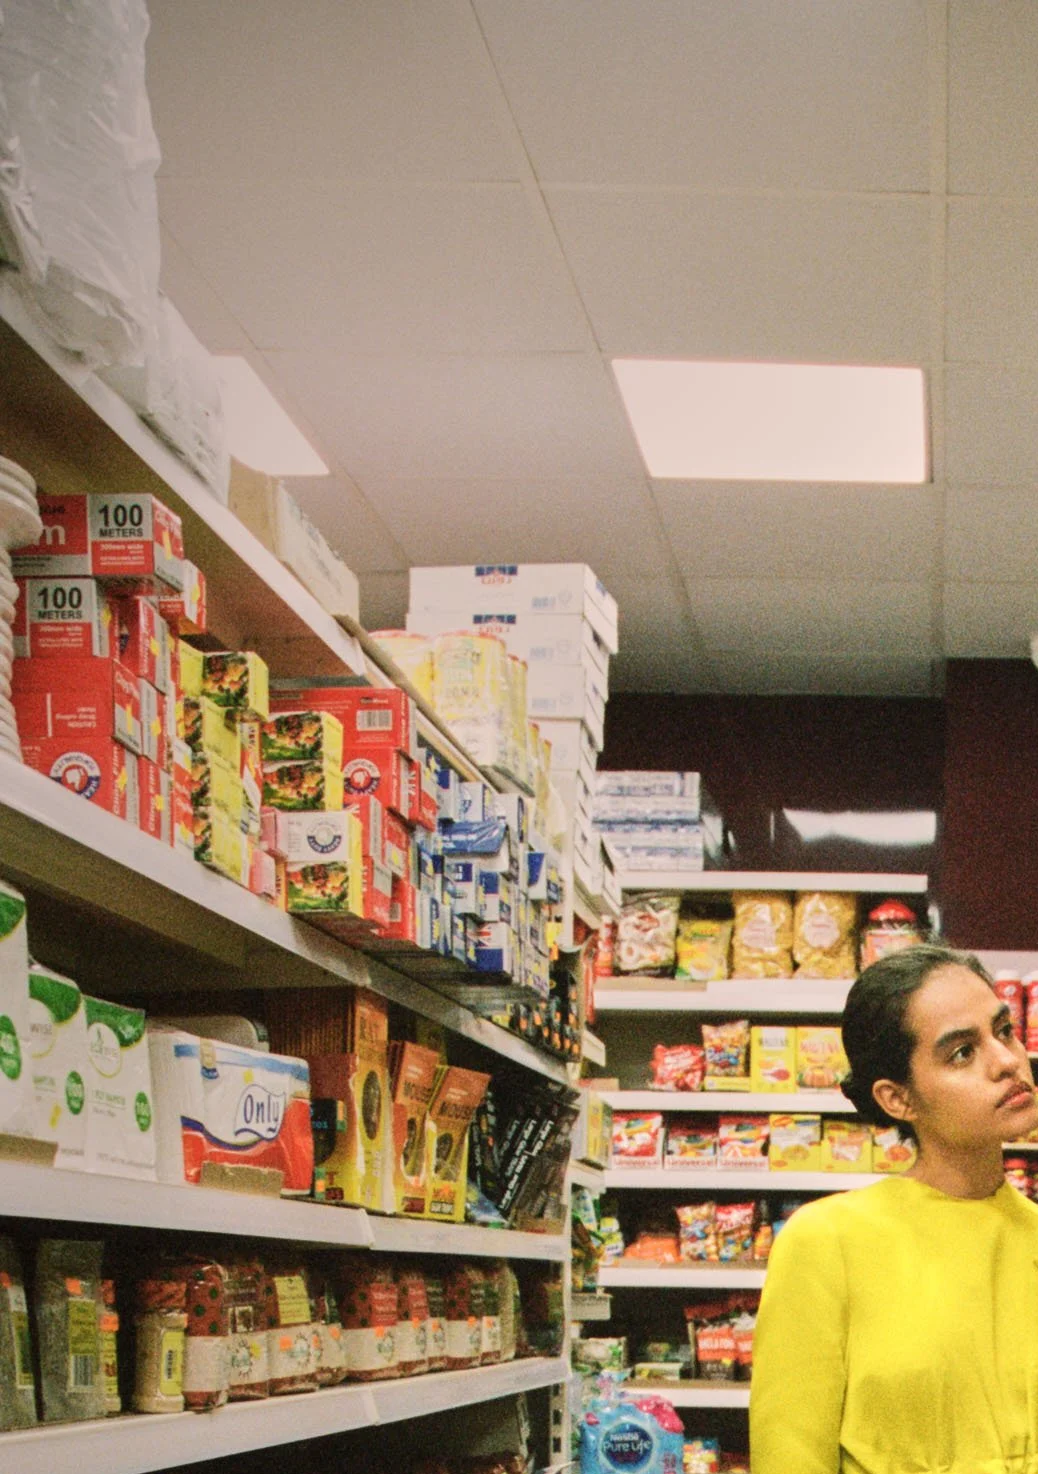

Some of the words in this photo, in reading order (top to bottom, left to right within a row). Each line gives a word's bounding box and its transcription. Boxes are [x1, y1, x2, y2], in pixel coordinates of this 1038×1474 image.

[98, 504, 143, 527] 100
[99, 528, 143, 538] METERS
[38, 587, 82, 609] 100
[38, 610, 82, 620] METERS
[243, 1094, 280, 1131] Only
[603, 1440, 631, 1453] Pure
[632, 1439, 652, 1454] Life
